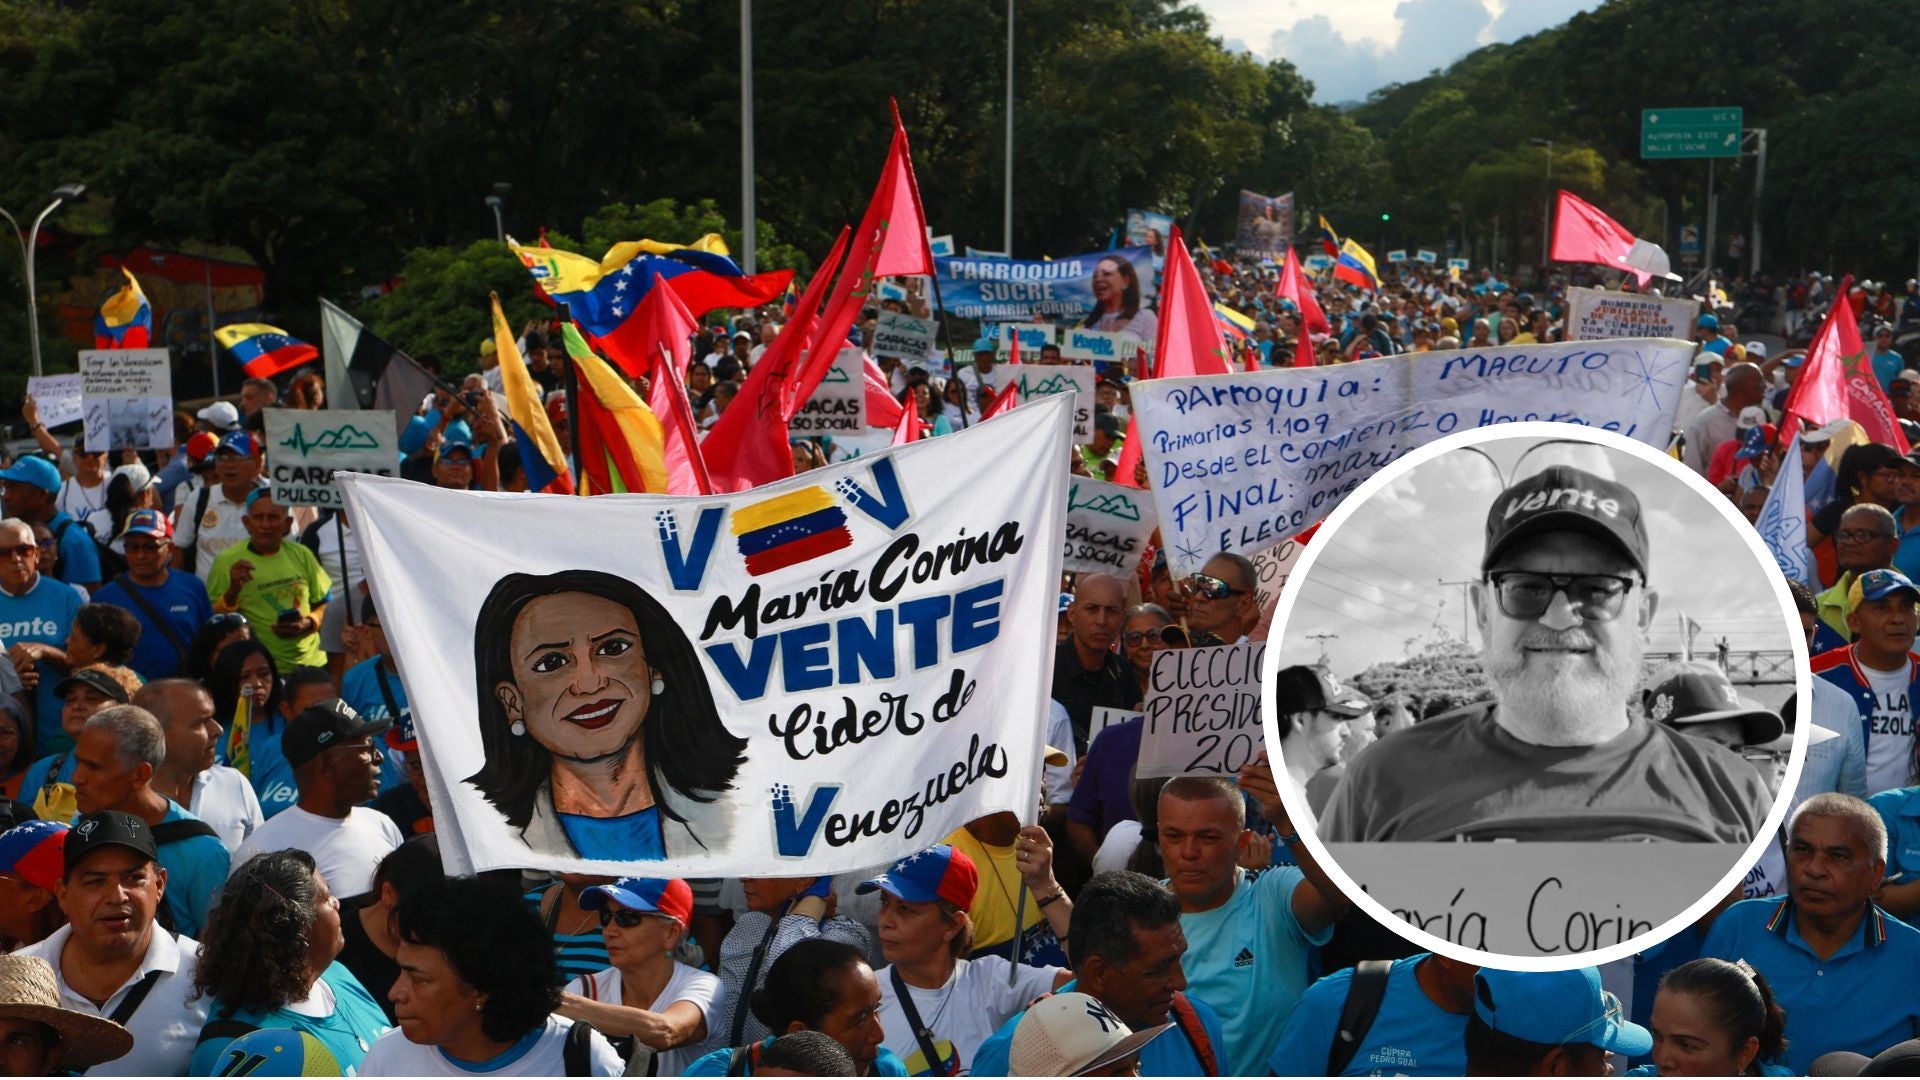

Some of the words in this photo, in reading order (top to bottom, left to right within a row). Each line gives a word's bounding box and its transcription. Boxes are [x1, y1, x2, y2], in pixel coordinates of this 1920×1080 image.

[950, 259, 1083, 281] PARROQUIA
[980, 281, 1055, 302] SUCRE
[955, 304, 984, 319] CON
[986, 303, 1030, 319] MARIA
[1032, 301, 1084, 316] CORINA
[1594, 306, 1659, 317] JUBILADOS
[1600, 300, 1662, 310] BOMBEROS
[1590, 312, 1605, 320] DE
[1613, 315, 1668, 325] CARACAS
[876, 332, 928, 351] CARACAS
[1440, 352, 1609, 380] MACUTO
[802, 399, 859, 414] ACAS
[815, 418, 859, 430] SOCIAL
[1266, 414, 1330, 437] 1.109
[1163, 456, 1238, 488] Desde
[277, 488, 330, 502] PULSO
[1075, 545, 1125, 568] SOCIAL
[700, 568, 870, 641] María
[868, 519, 1025, 603] Corina
[0, 617, 58, 638] ente
[704, 579, 1005, 702] VENTE
[932, 668, 977, 723] de
[1886, 693, 1908, 712] LA
[770, 732, 1008, 857] Venezuela
[1234, 959, 1254, 968] adida
[1370, 1054, 1396, 1064] PEDRO
[1397, 1057, 1418, 1068] GUAL
[1381, 1046, 1412, 1057] CÚPIRA
